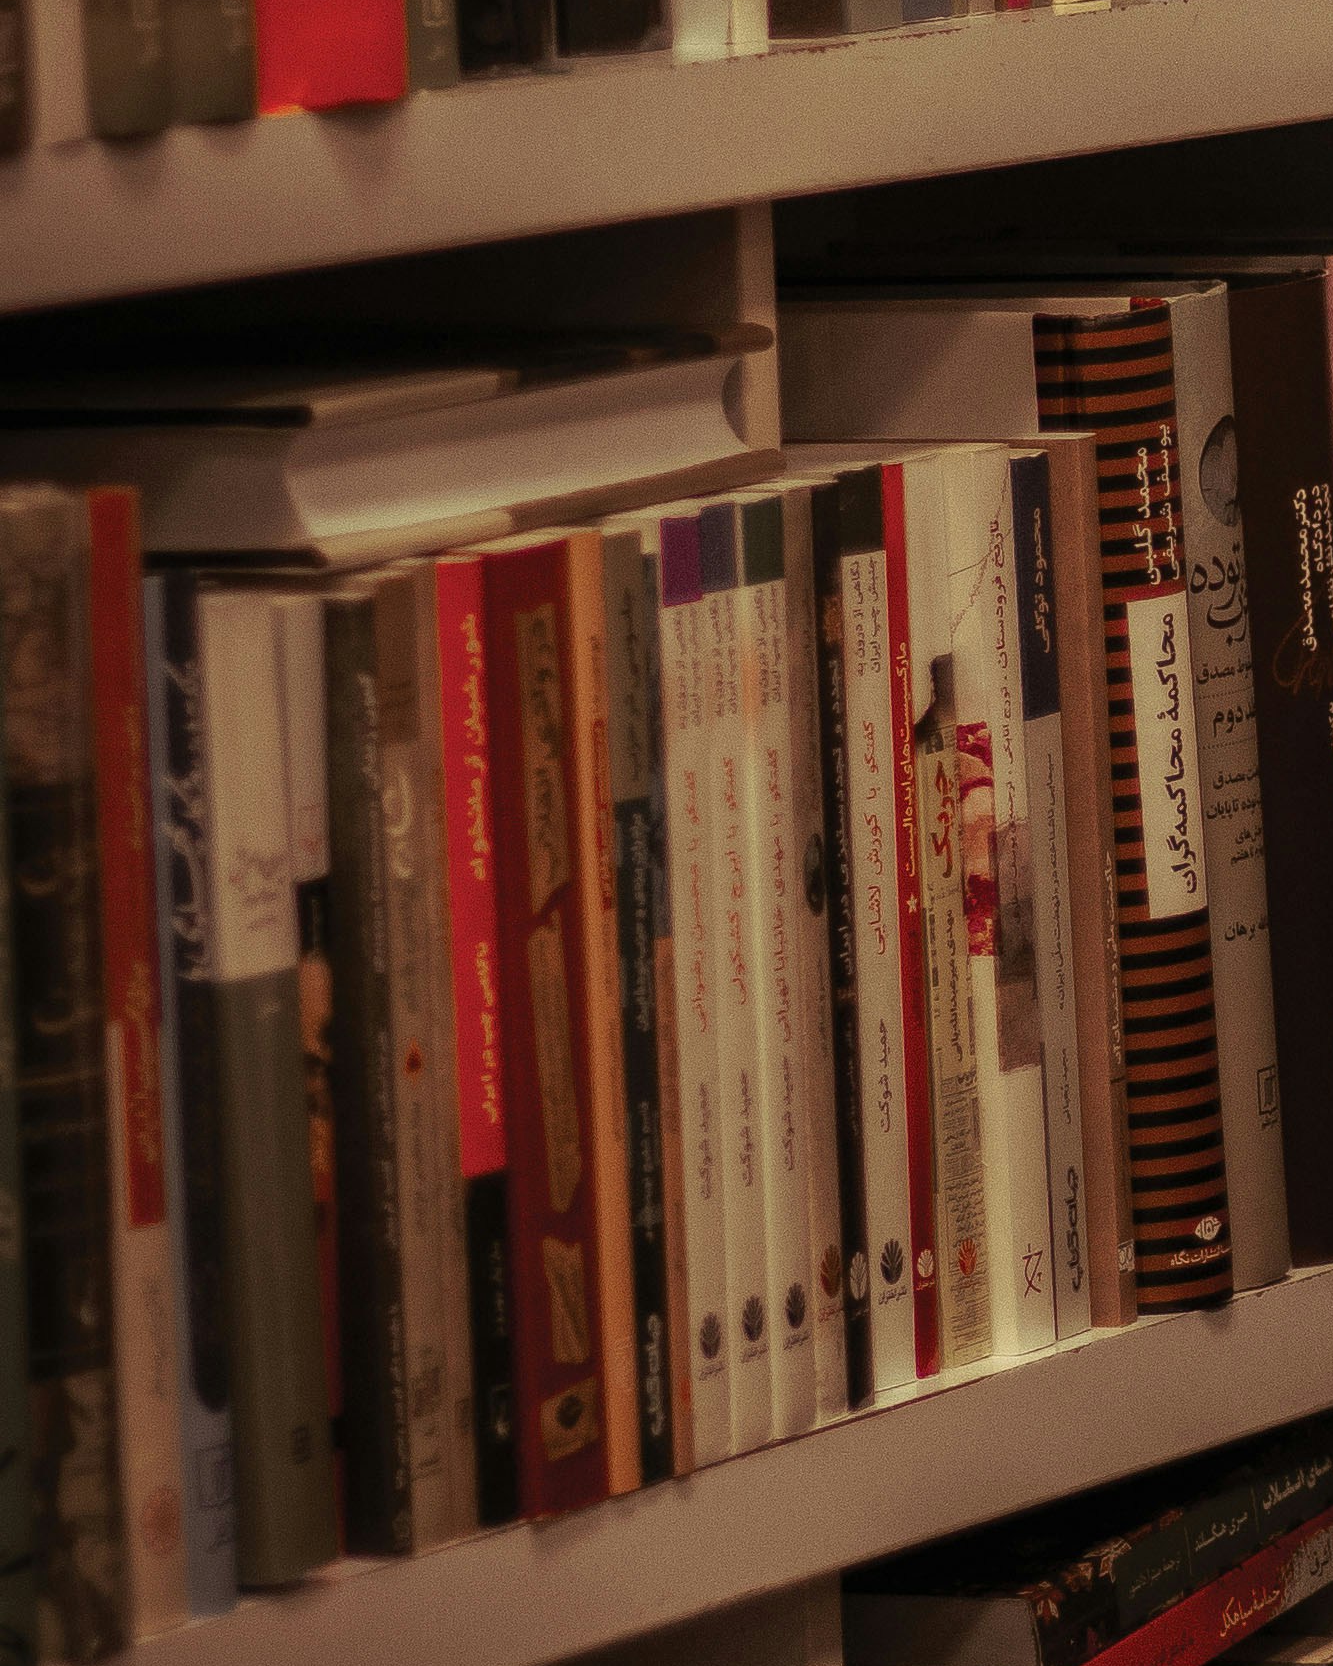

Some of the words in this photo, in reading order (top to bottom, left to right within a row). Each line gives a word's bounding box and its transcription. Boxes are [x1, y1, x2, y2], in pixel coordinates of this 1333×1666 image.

[1135, 446, 1151, 518] محمد
[1157, 423, 1172, 494] یوسف
[1291, 487, 1311, 524] دکتر
[1029, 506, 1047, 587] محمود
[1132, 522, 1162, 584] گلبن
[1160, 501, 1181, 579] شریفی
[1299, 528, 1311, 584] محمد
[1032, 591, 1053, 653] توکلی
[1301, 586, 1318, 651] مصدق
[862, 719, 879, 774] گفتگو
[878, 1017, 891, 1068] حمید
[877, 1072, 892, 1132] شوکت
